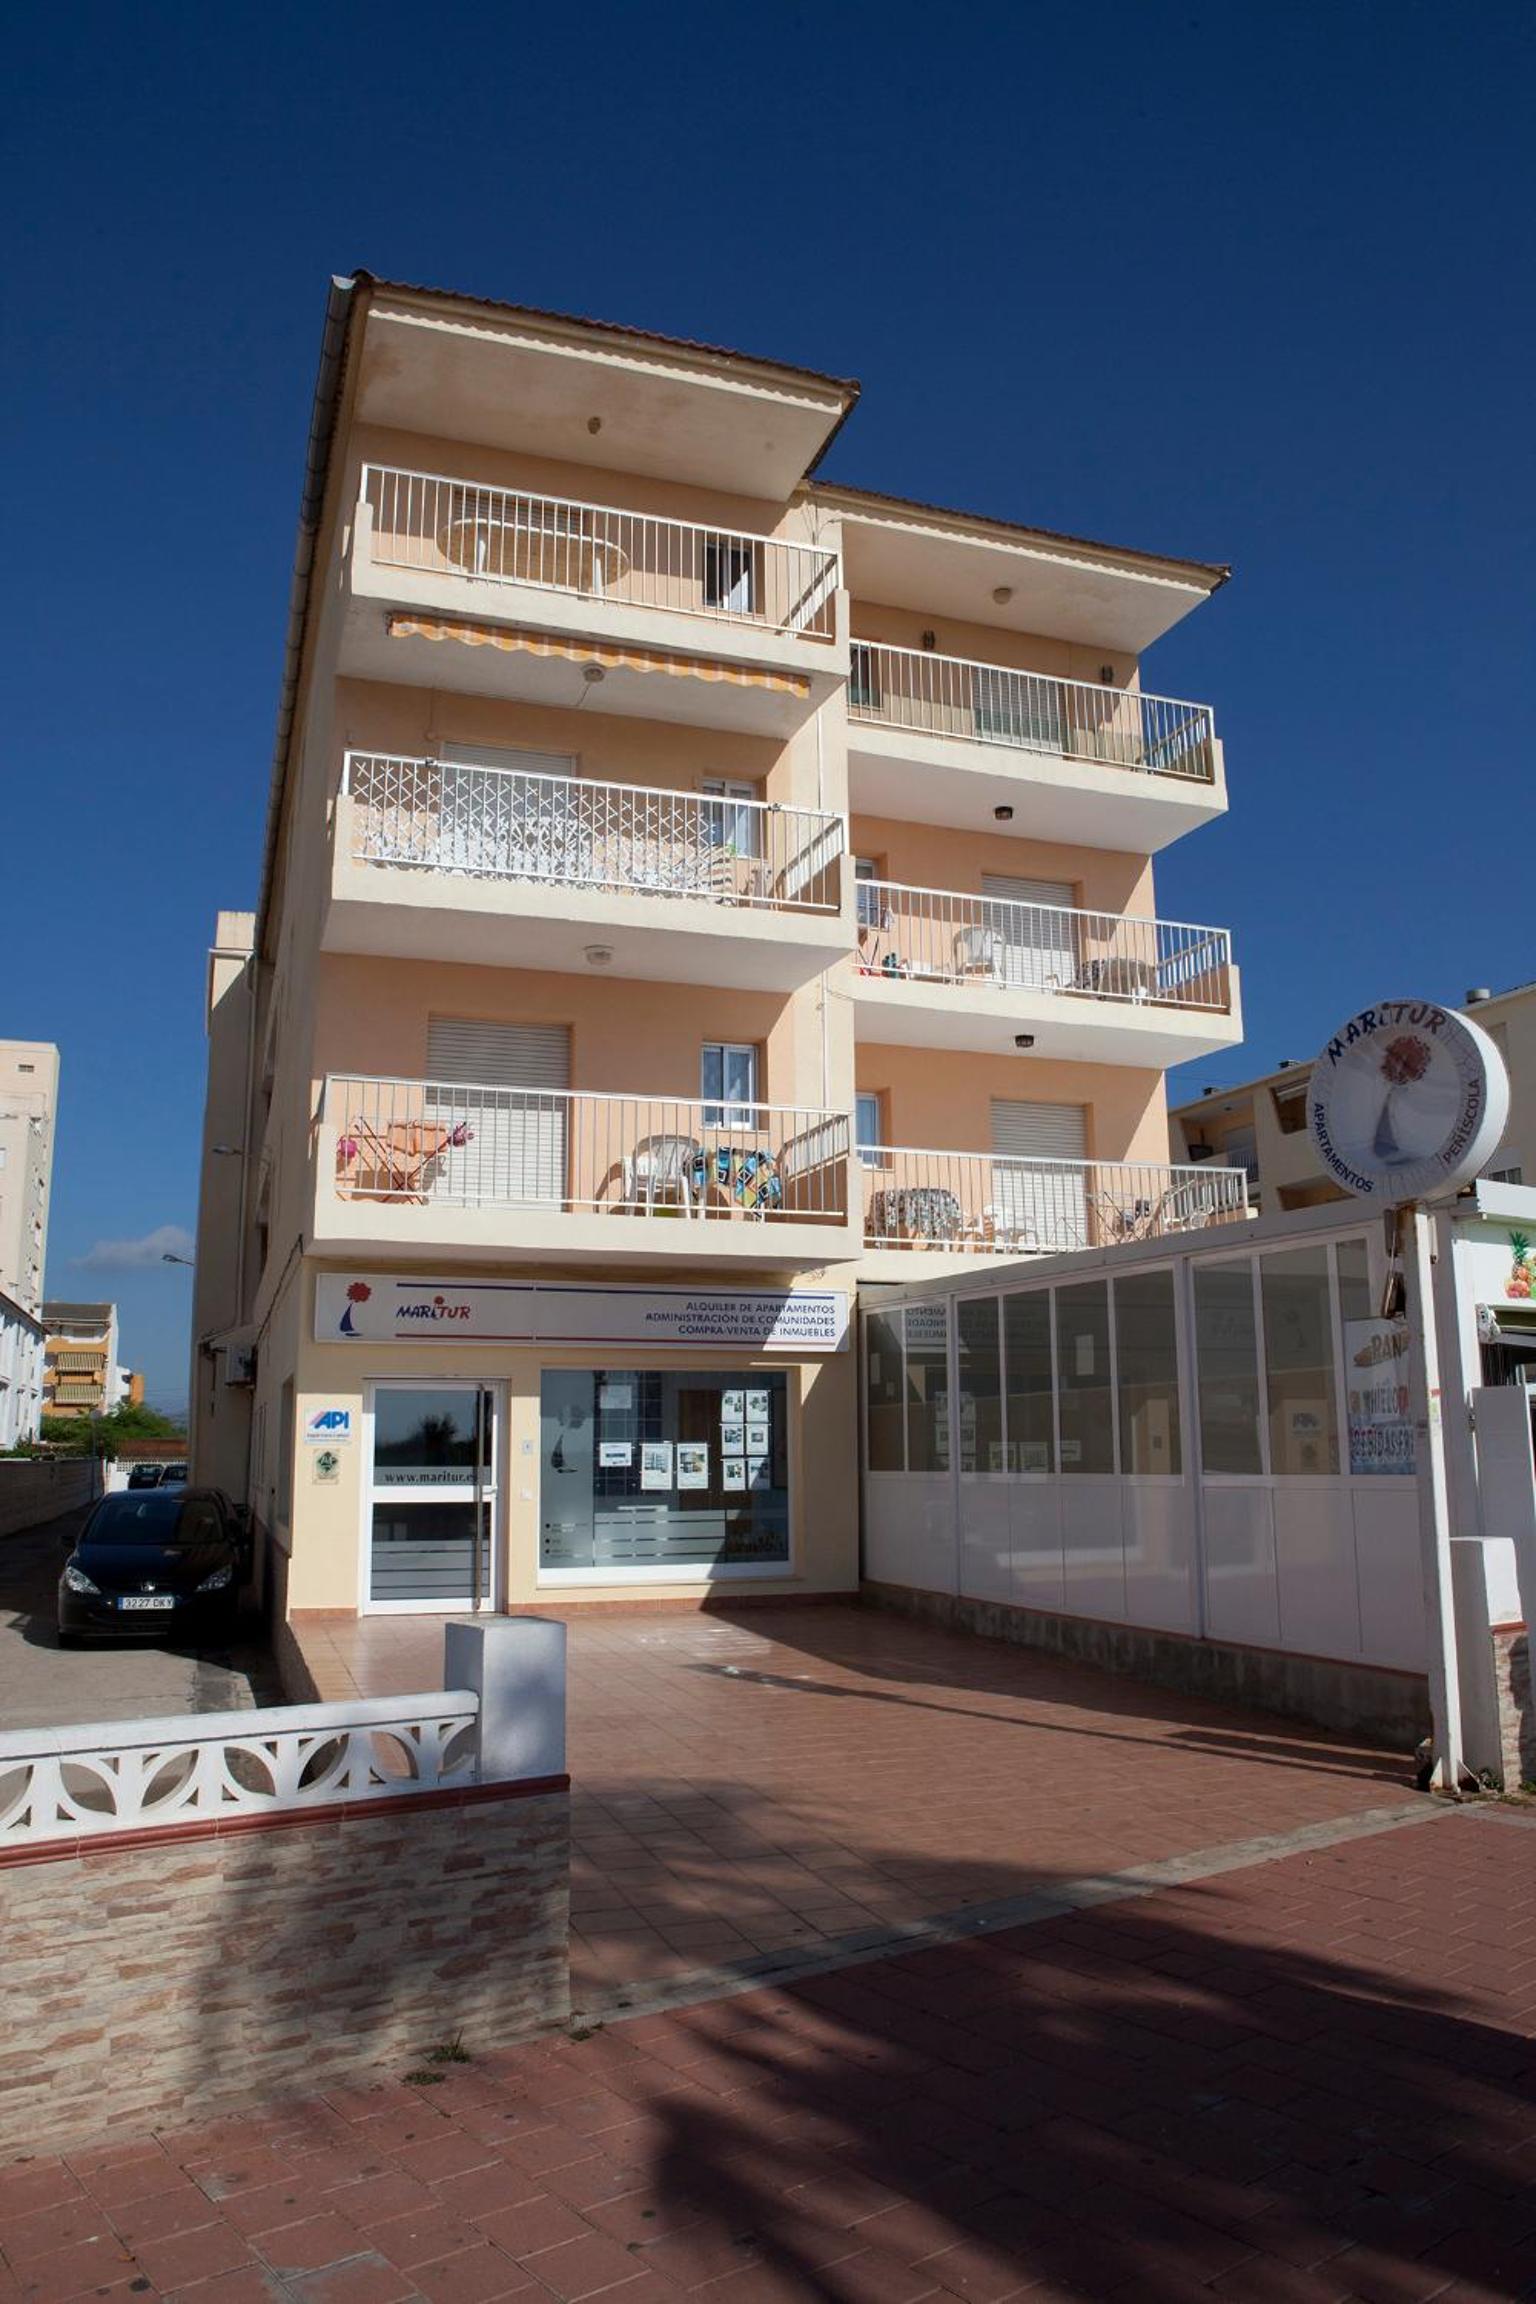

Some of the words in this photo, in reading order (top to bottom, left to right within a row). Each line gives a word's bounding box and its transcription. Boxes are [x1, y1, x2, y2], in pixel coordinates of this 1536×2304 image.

[1313, 1102, 1375, 1194] APARTAMENTOS
[686, 1301, 737, 1313] ALQUILER
[739, 1303, 754, 1313] DE
[755, 1303, 836, 1315] APARTAMENTOS
[741, 1314, 755, 1325] DE
[757, 1315, 836, 1327] COMUNIDADES
[763, 1326, 778, 1337] DE
[779, 1327, 837, 1339] INMUEBLES
[311, 1410, 350, 1430] API
